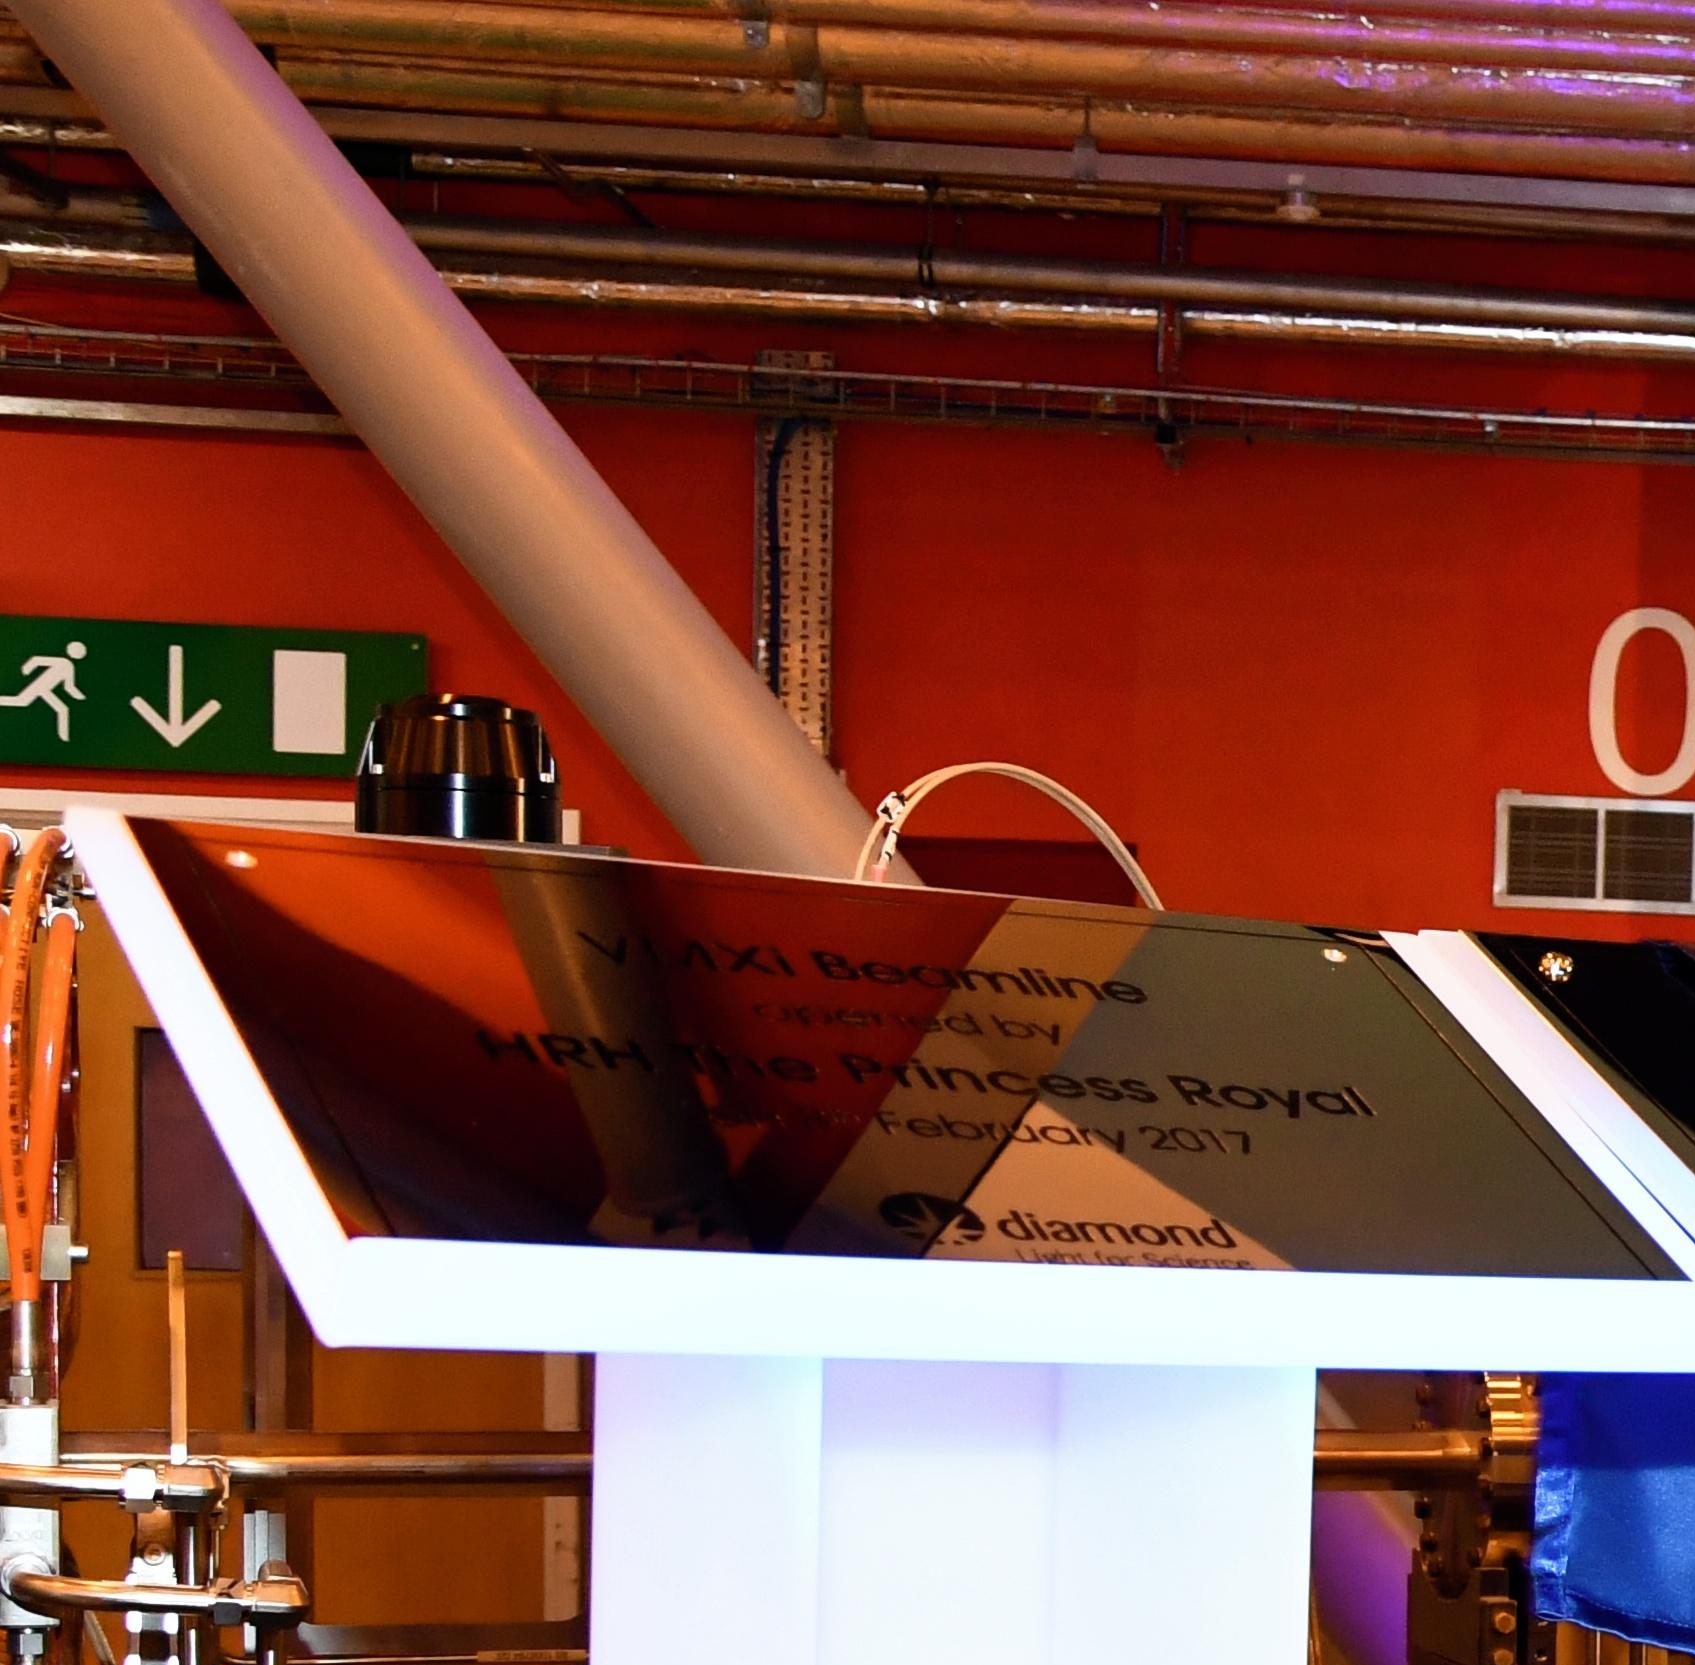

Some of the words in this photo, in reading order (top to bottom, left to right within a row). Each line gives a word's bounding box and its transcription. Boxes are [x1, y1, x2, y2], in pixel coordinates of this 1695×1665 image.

[810, 950, 1148, 1004] Beamline
[753, 1003, 984, 1037] opened
[988, 1013, 1061, 1046] by
[474, 1029, 654, 1073] HRH
[666, 1041, 818, 1083] The
[840, 1053, 1158, 1102] Princess
[1166, 1074, 1376, 1119] Royal
[874, 1110, 1126, 1153] February
[1138, 1125, 1250, 1154] 2017
[997, 1209, 1238, 1249] diamond
[1014, 1247, 1085, 1265] Light
[1094, 1250, 1134, 1266] for
[1141, 1251, 1251, 1269] Science
